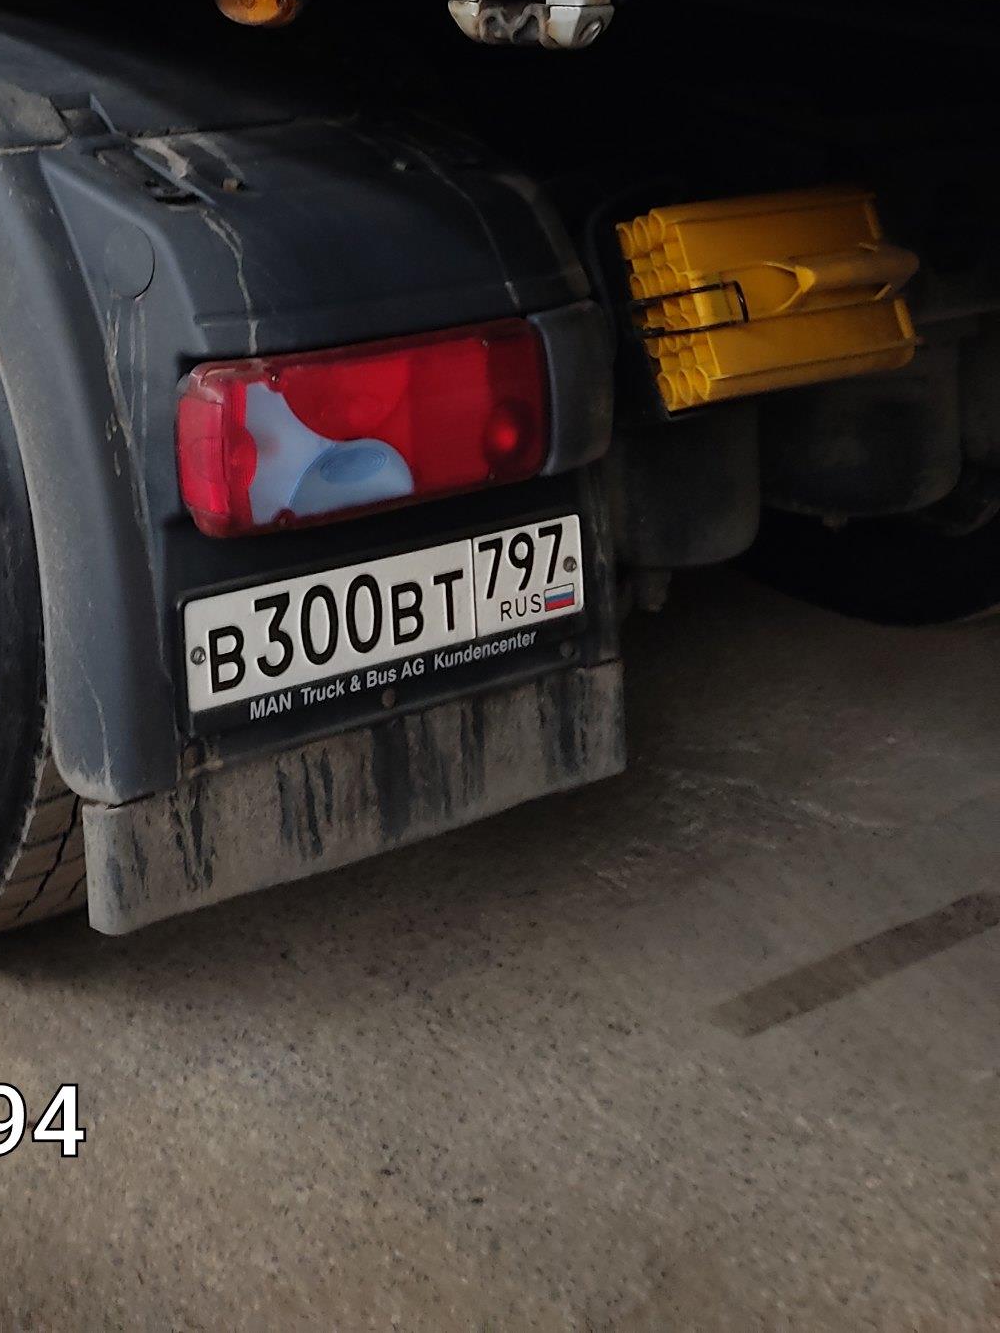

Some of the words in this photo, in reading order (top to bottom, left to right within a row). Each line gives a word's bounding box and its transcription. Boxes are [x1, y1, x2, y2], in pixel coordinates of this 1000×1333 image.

[478, 523, 563, 601] 797
[501, 593, 542, 622] RUS
[250, 692, 293, 720] MAN
[300, 679, 346, 706] Truck
[350, 674, 362, 693] &
[366, 668, 397, 688] Bus
[401, 657, 425, 680] AG
[434, 630, 538, 670] Kundencenter
